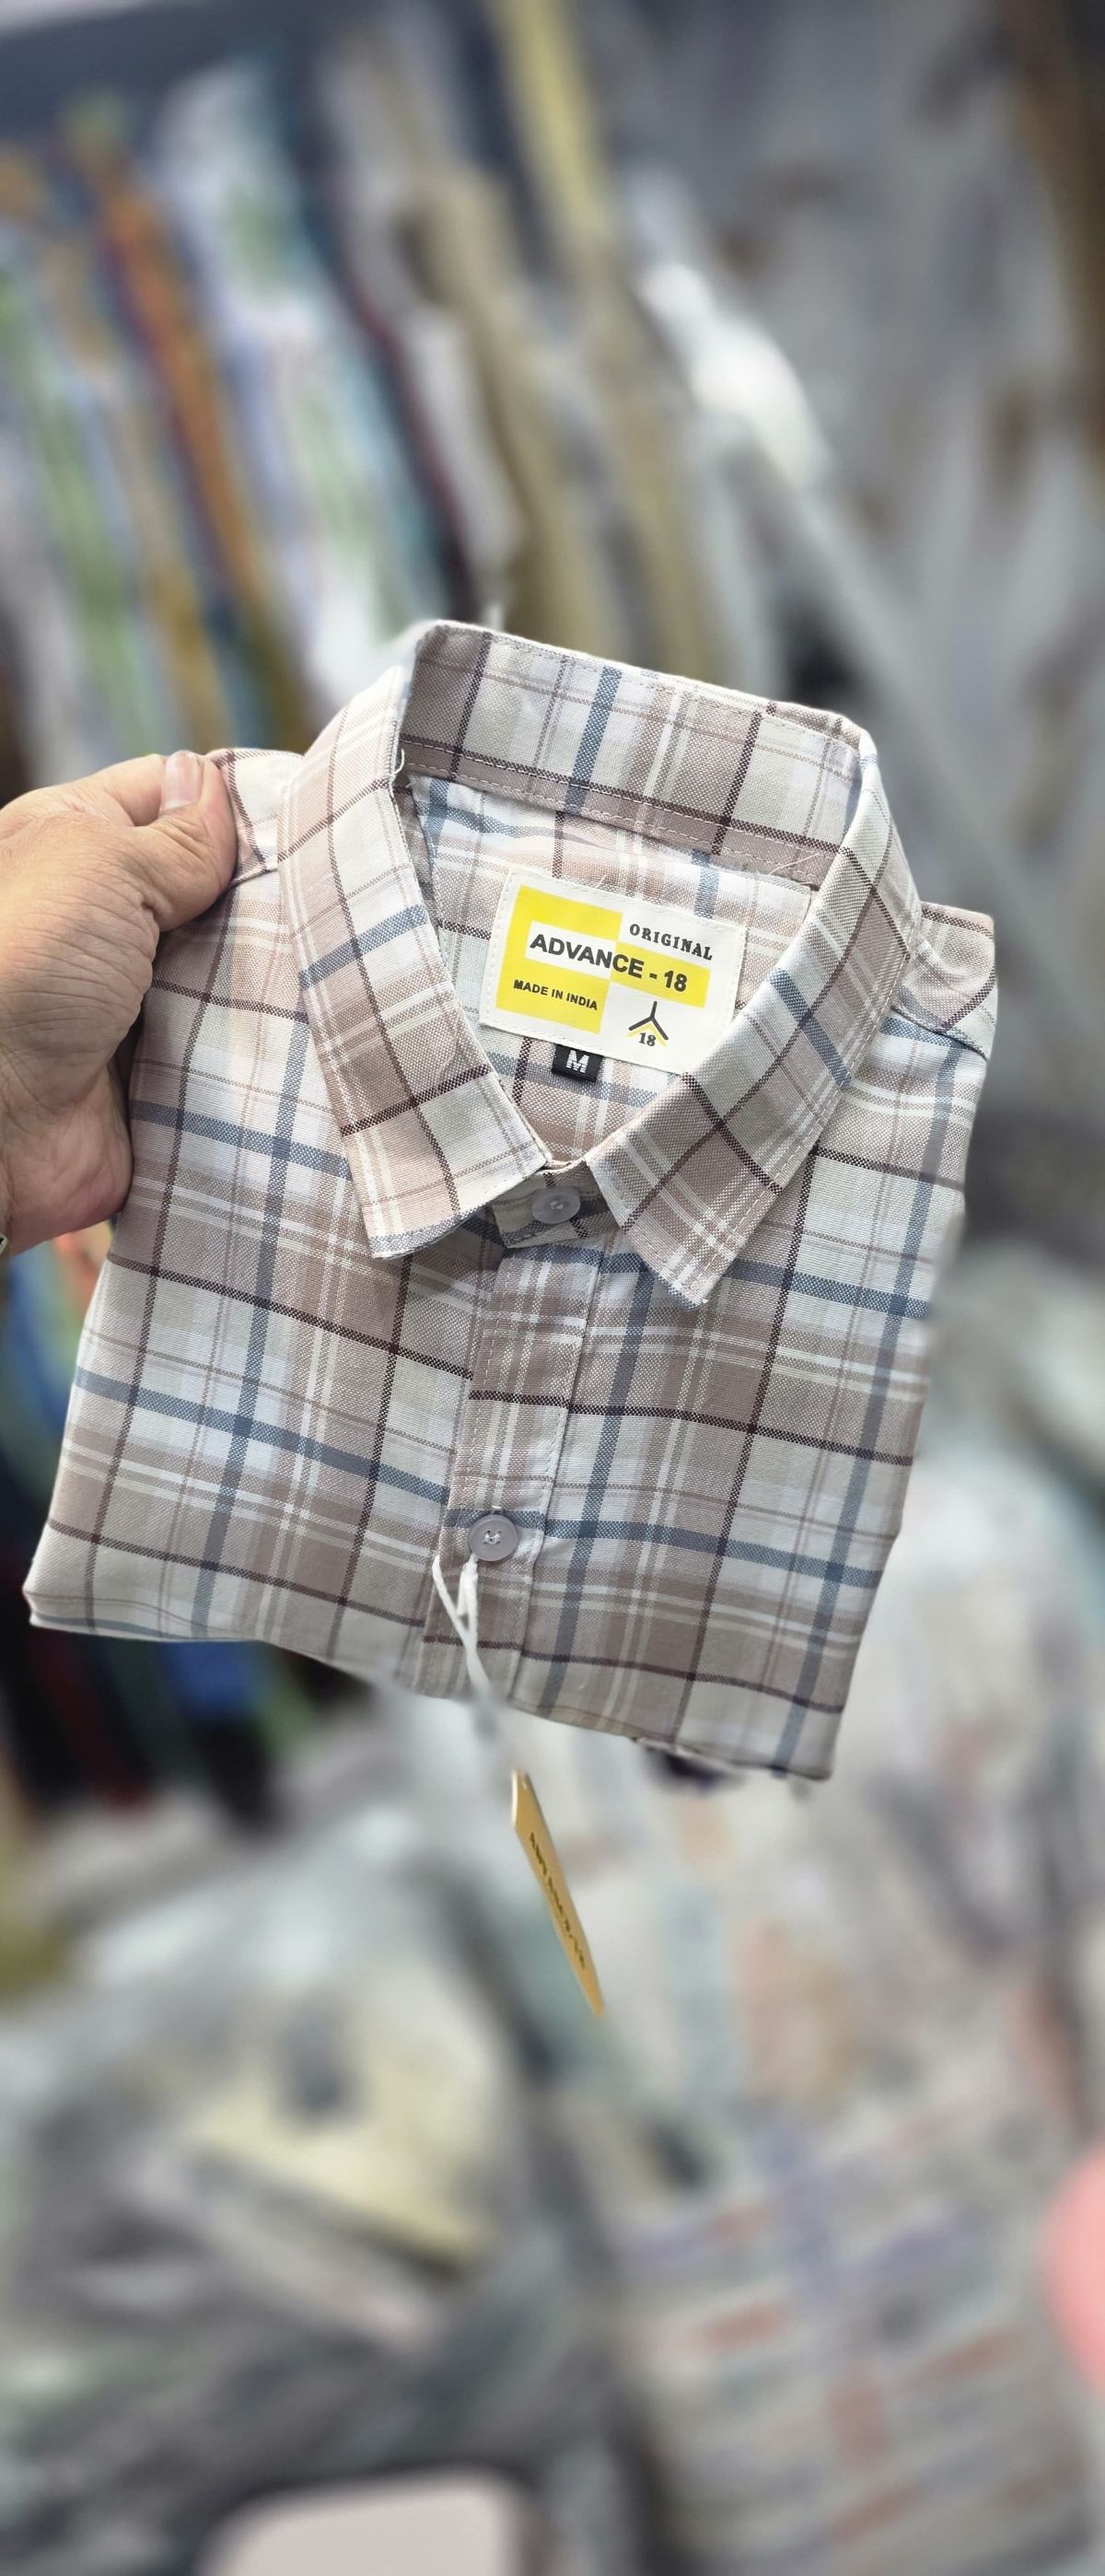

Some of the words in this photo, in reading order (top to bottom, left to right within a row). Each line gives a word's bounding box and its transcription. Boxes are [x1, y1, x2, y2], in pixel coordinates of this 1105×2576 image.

[629, 924, 713, 961] ORIGINAL
[529, 934, 645, 979] ADVANCE
[664, 970, 688, 992] 18
[513, 979, 549, 996] MADE
[551, 988, 564, 999] IN
[566, 993, 599, 1010] INDIA
[638, 1032, 657, 1046] 18
[565, 1050, 589, 1073] M
